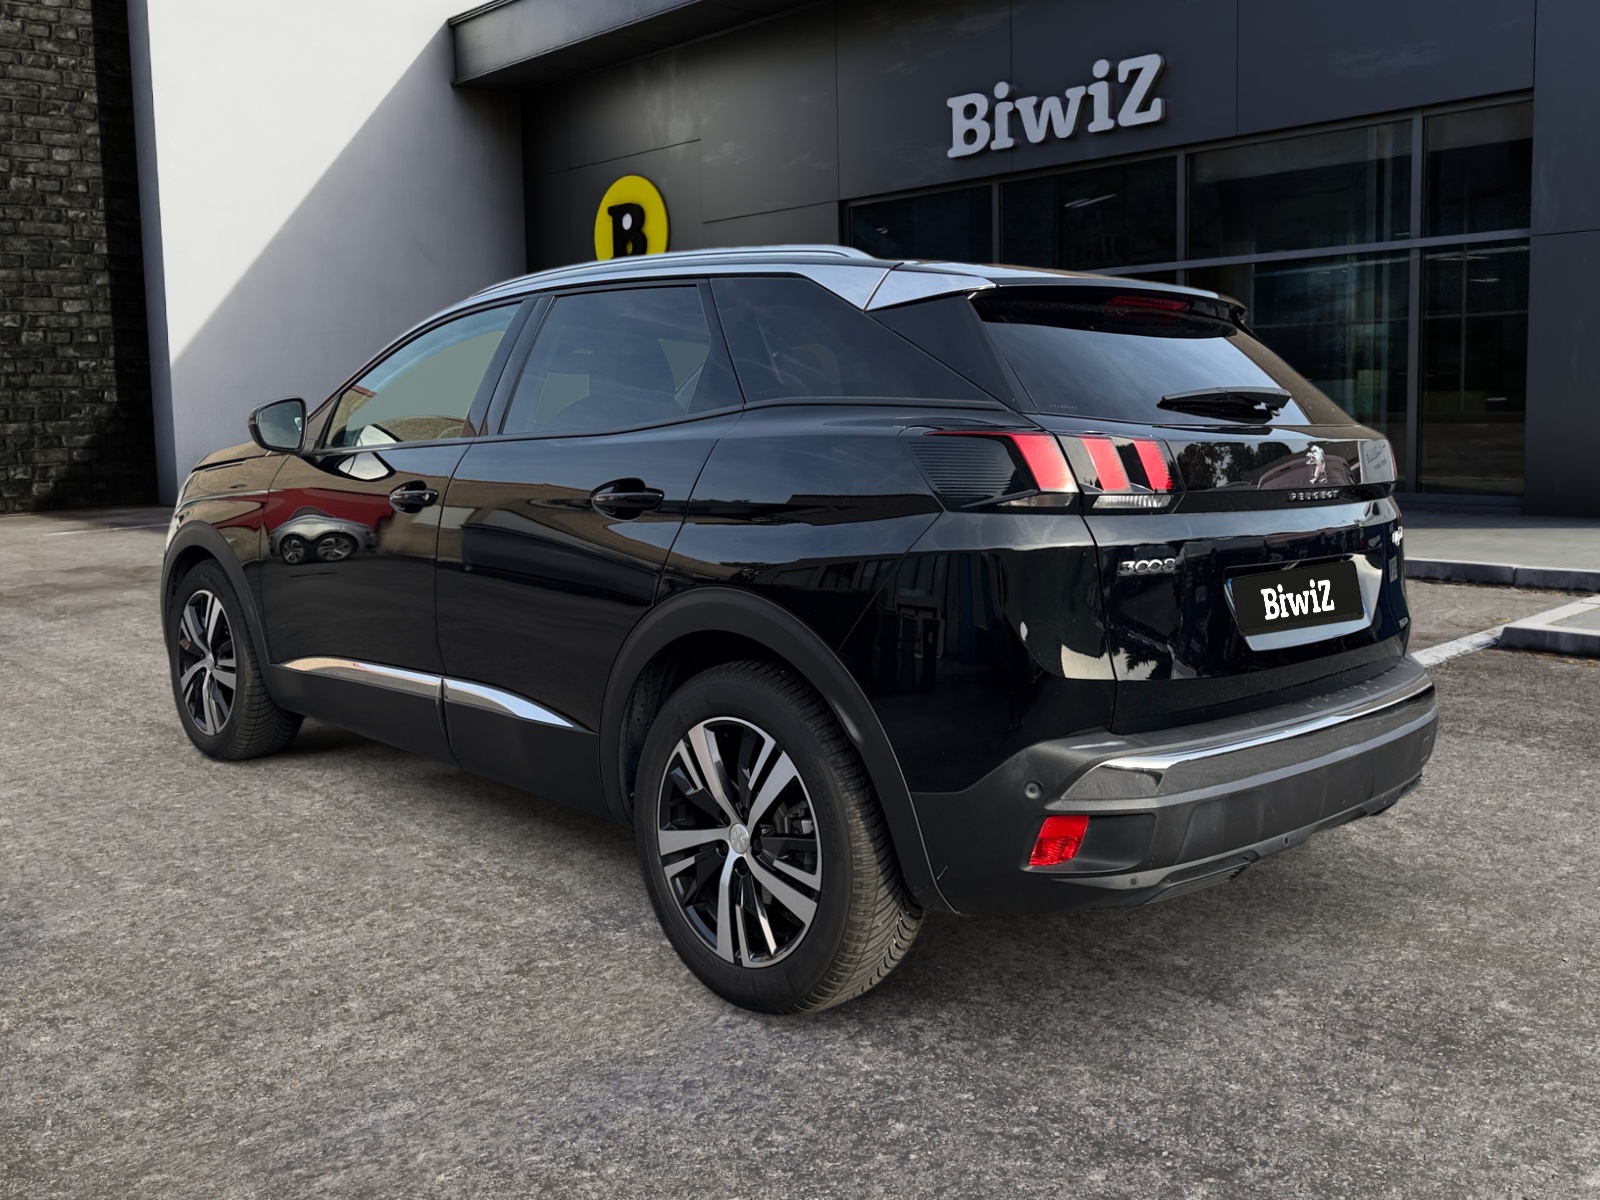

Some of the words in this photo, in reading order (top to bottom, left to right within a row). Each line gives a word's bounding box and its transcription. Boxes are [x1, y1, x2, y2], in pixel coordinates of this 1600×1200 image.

[947, 53, 1164, 158] BiwiZ
[607, 203, 648, 259] B
[1117, 558, 1176, 576] 3008
